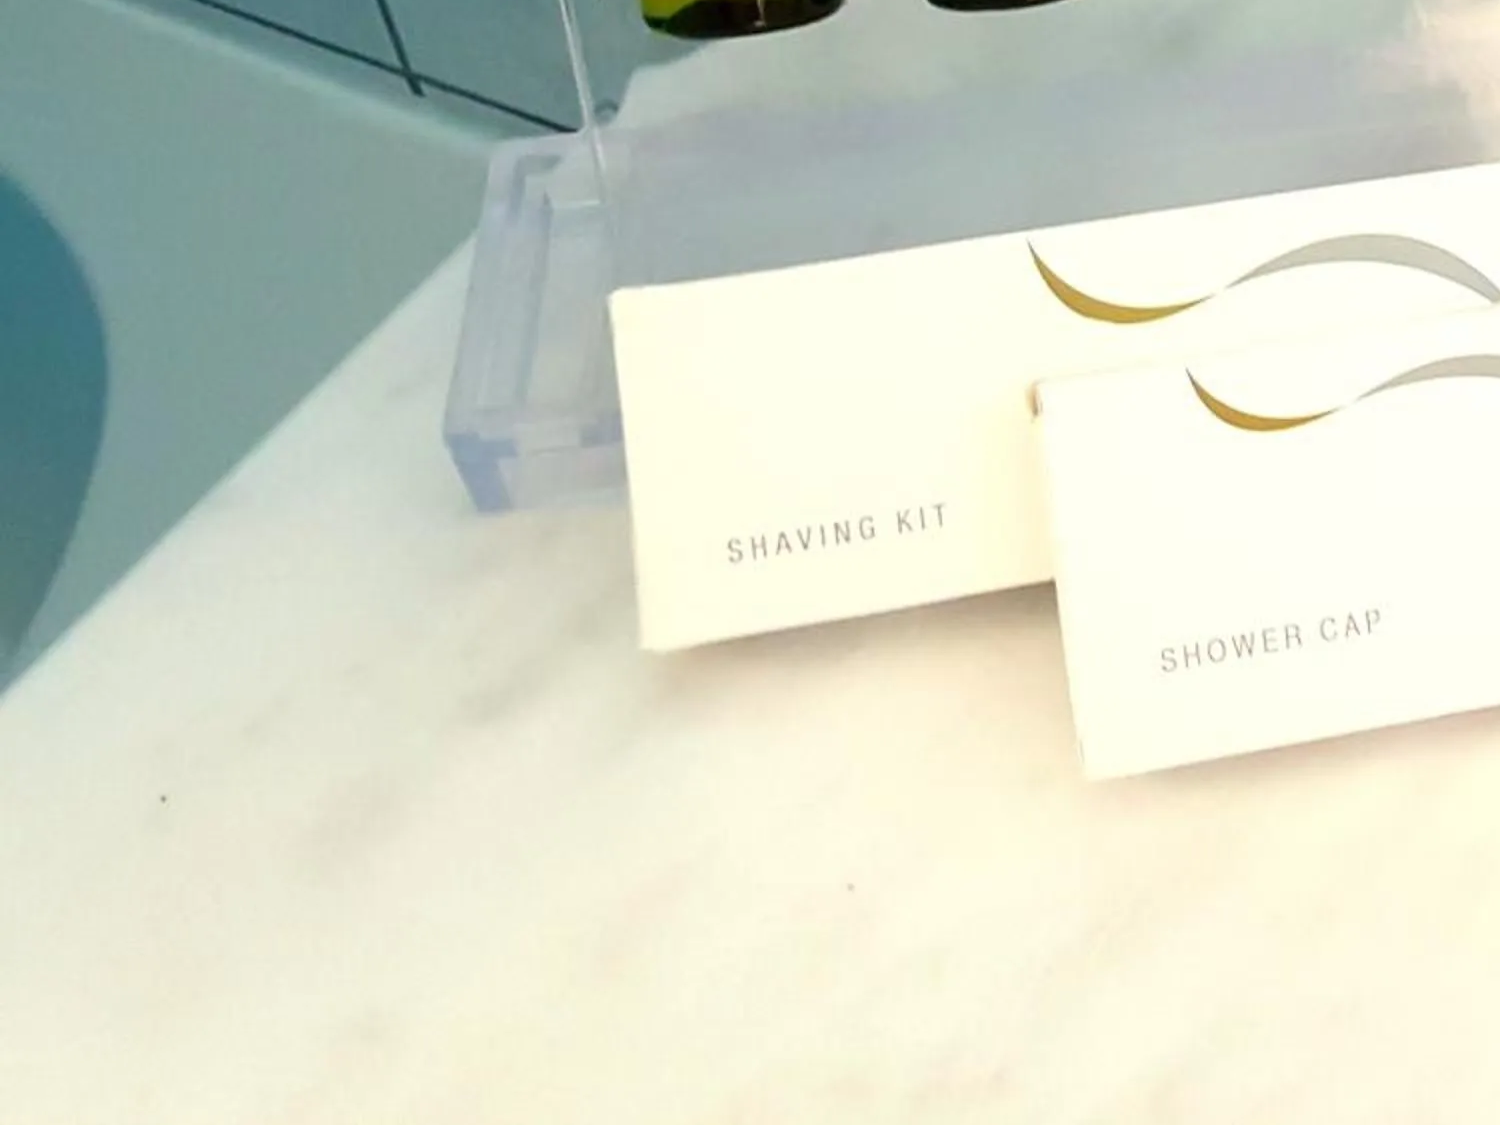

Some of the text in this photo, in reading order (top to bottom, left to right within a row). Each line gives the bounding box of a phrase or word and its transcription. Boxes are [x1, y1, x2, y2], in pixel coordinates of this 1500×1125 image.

[726, 502, 946, 564] SHAVING KIT
[1160, 608, 1382, 673] SHOWER CAP
